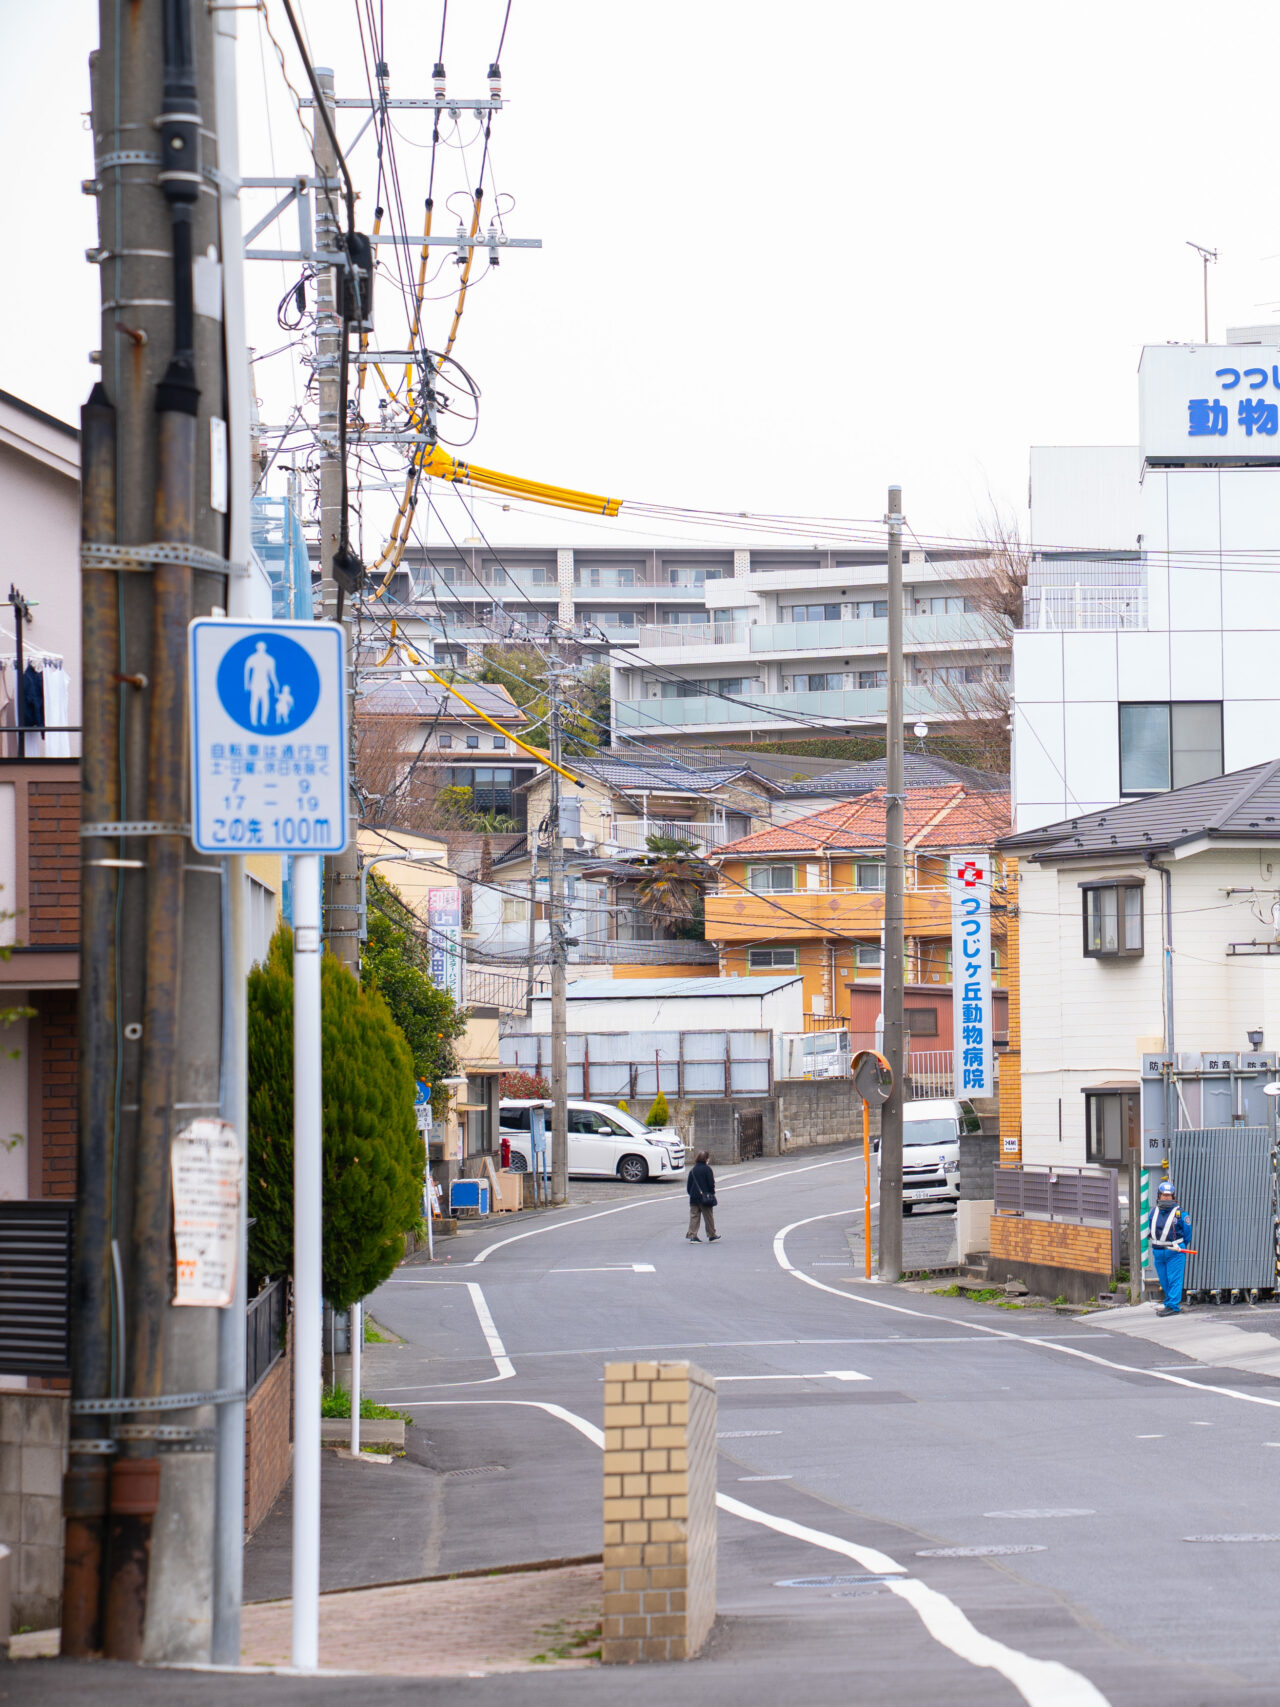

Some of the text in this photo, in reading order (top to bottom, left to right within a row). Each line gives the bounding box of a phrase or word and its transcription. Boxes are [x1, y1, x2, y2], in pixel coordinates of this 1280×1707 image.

[212, 817, 332, 843] この先 100m
[1209, 1060, 1231, 1070] 防音
